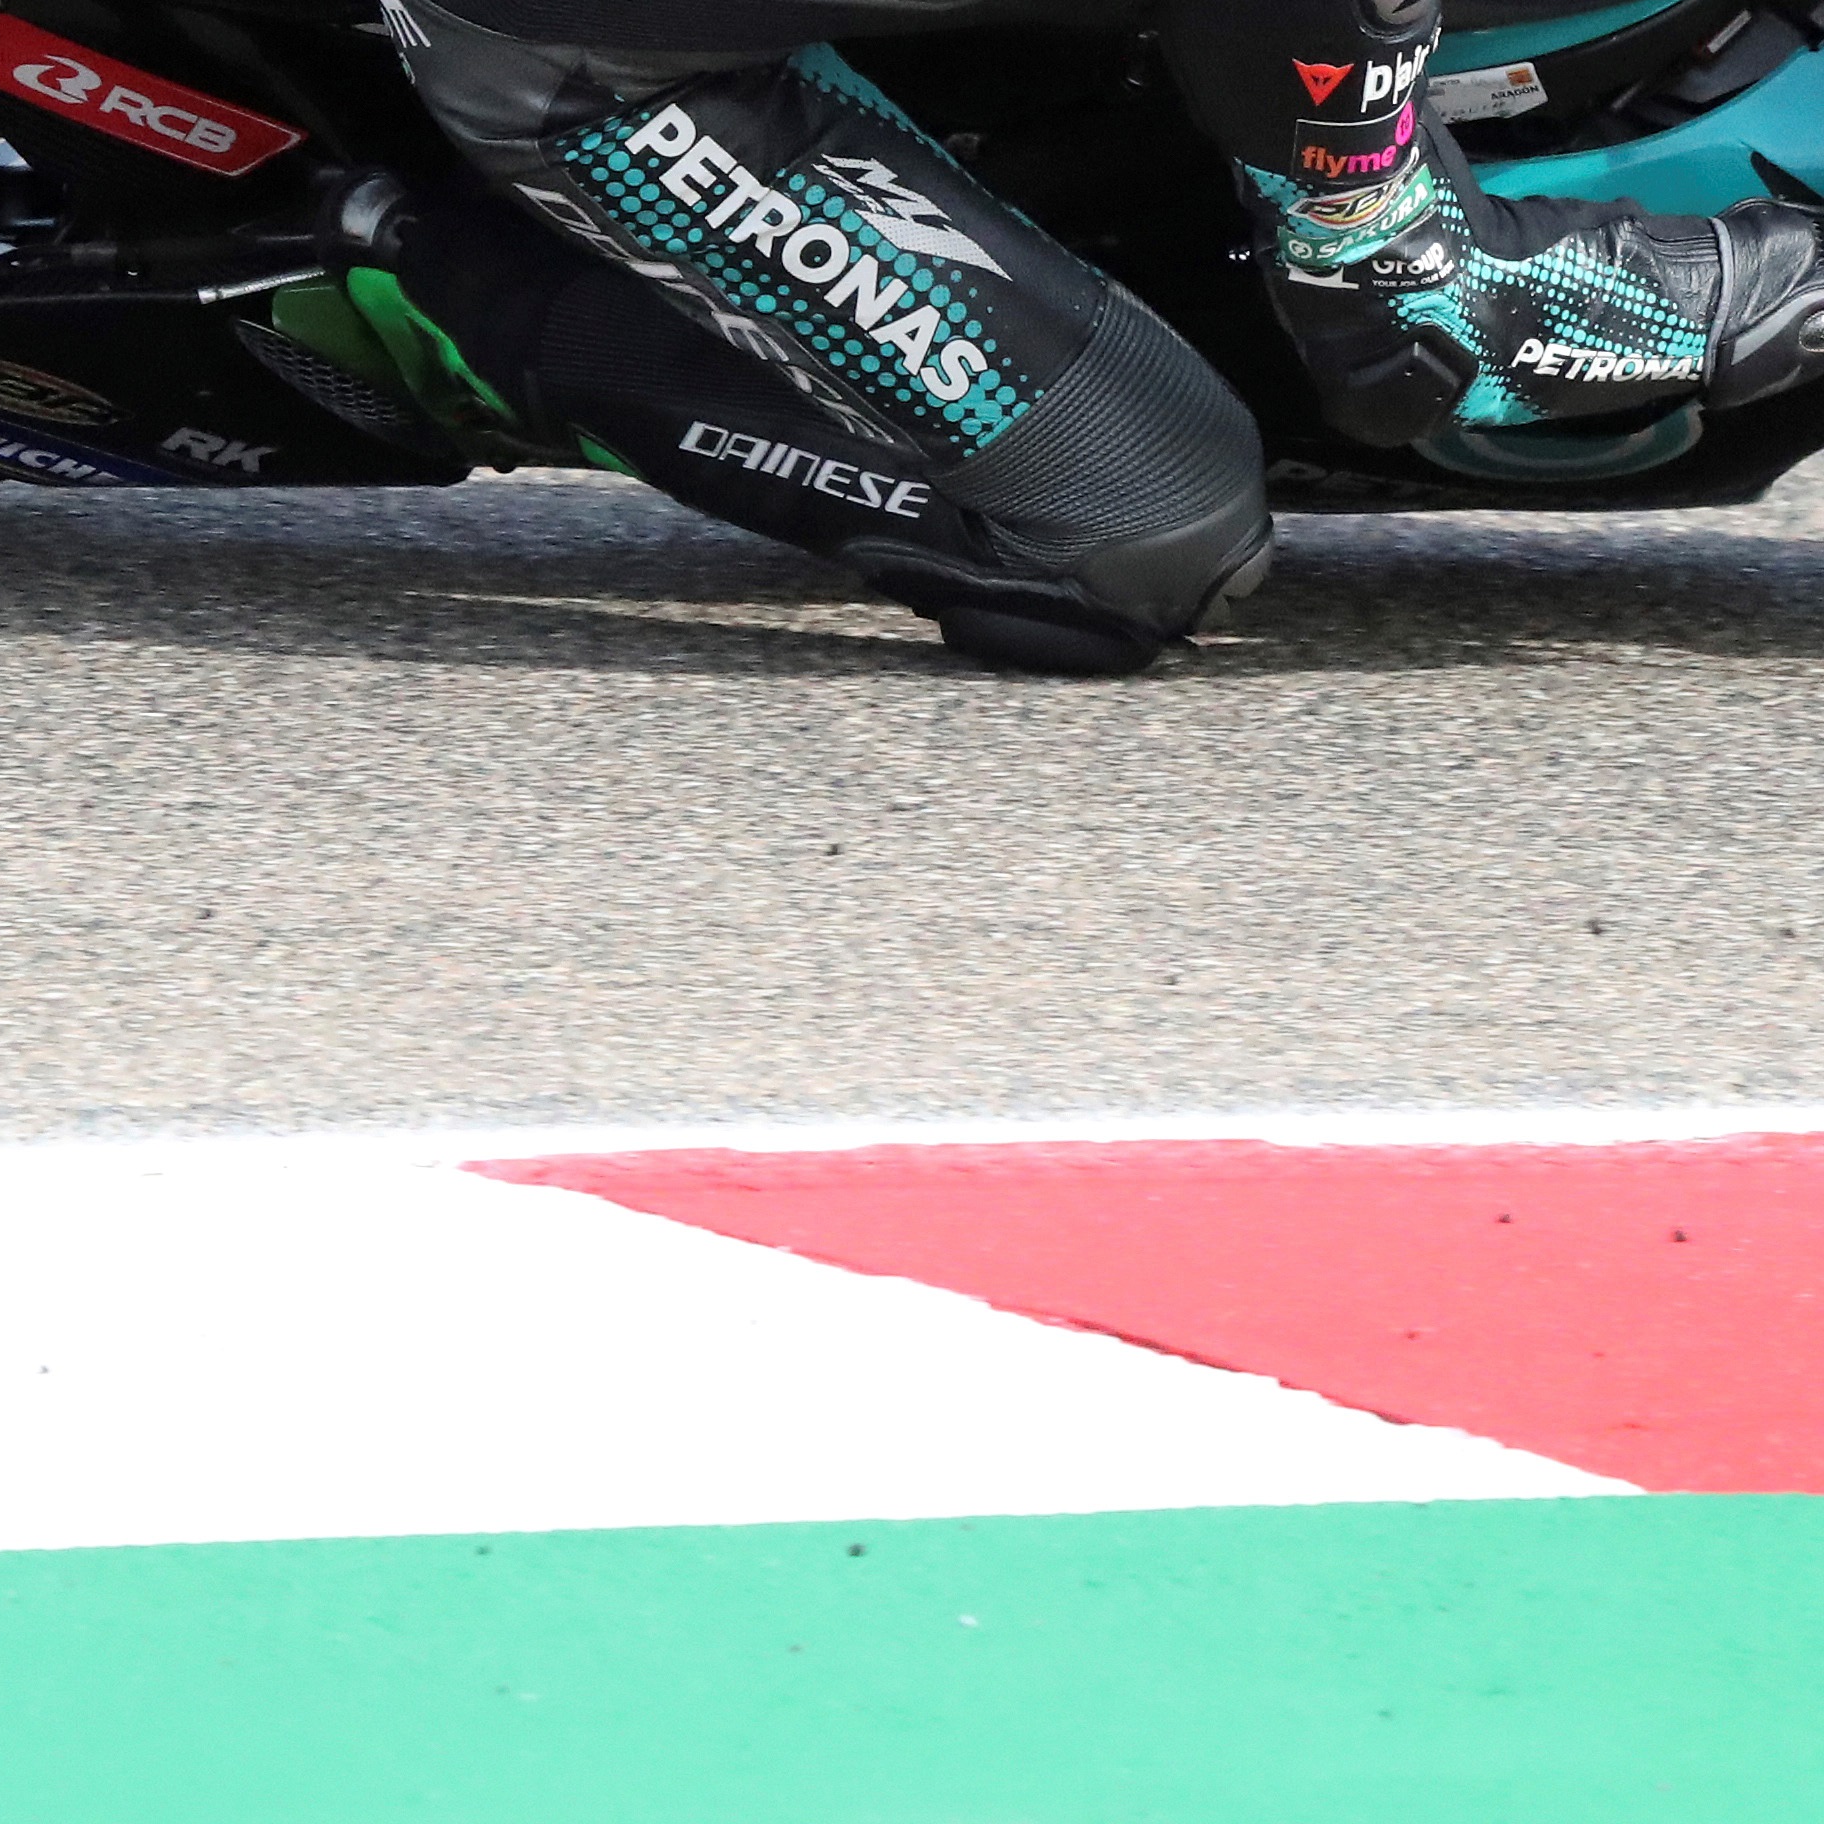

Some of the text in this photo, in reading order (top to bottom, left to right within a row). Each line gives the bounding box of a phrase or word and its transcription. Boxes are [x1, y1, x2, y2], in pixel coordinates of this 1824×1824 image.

[99, 89, 236, 154] RCB
[625, 103, 988, 402] PETRONAS
[1317, 183, 1428, 259] SAKURA
[160, 426, 279, 472] RK
[679, 421, 930, 518] DAINESE
